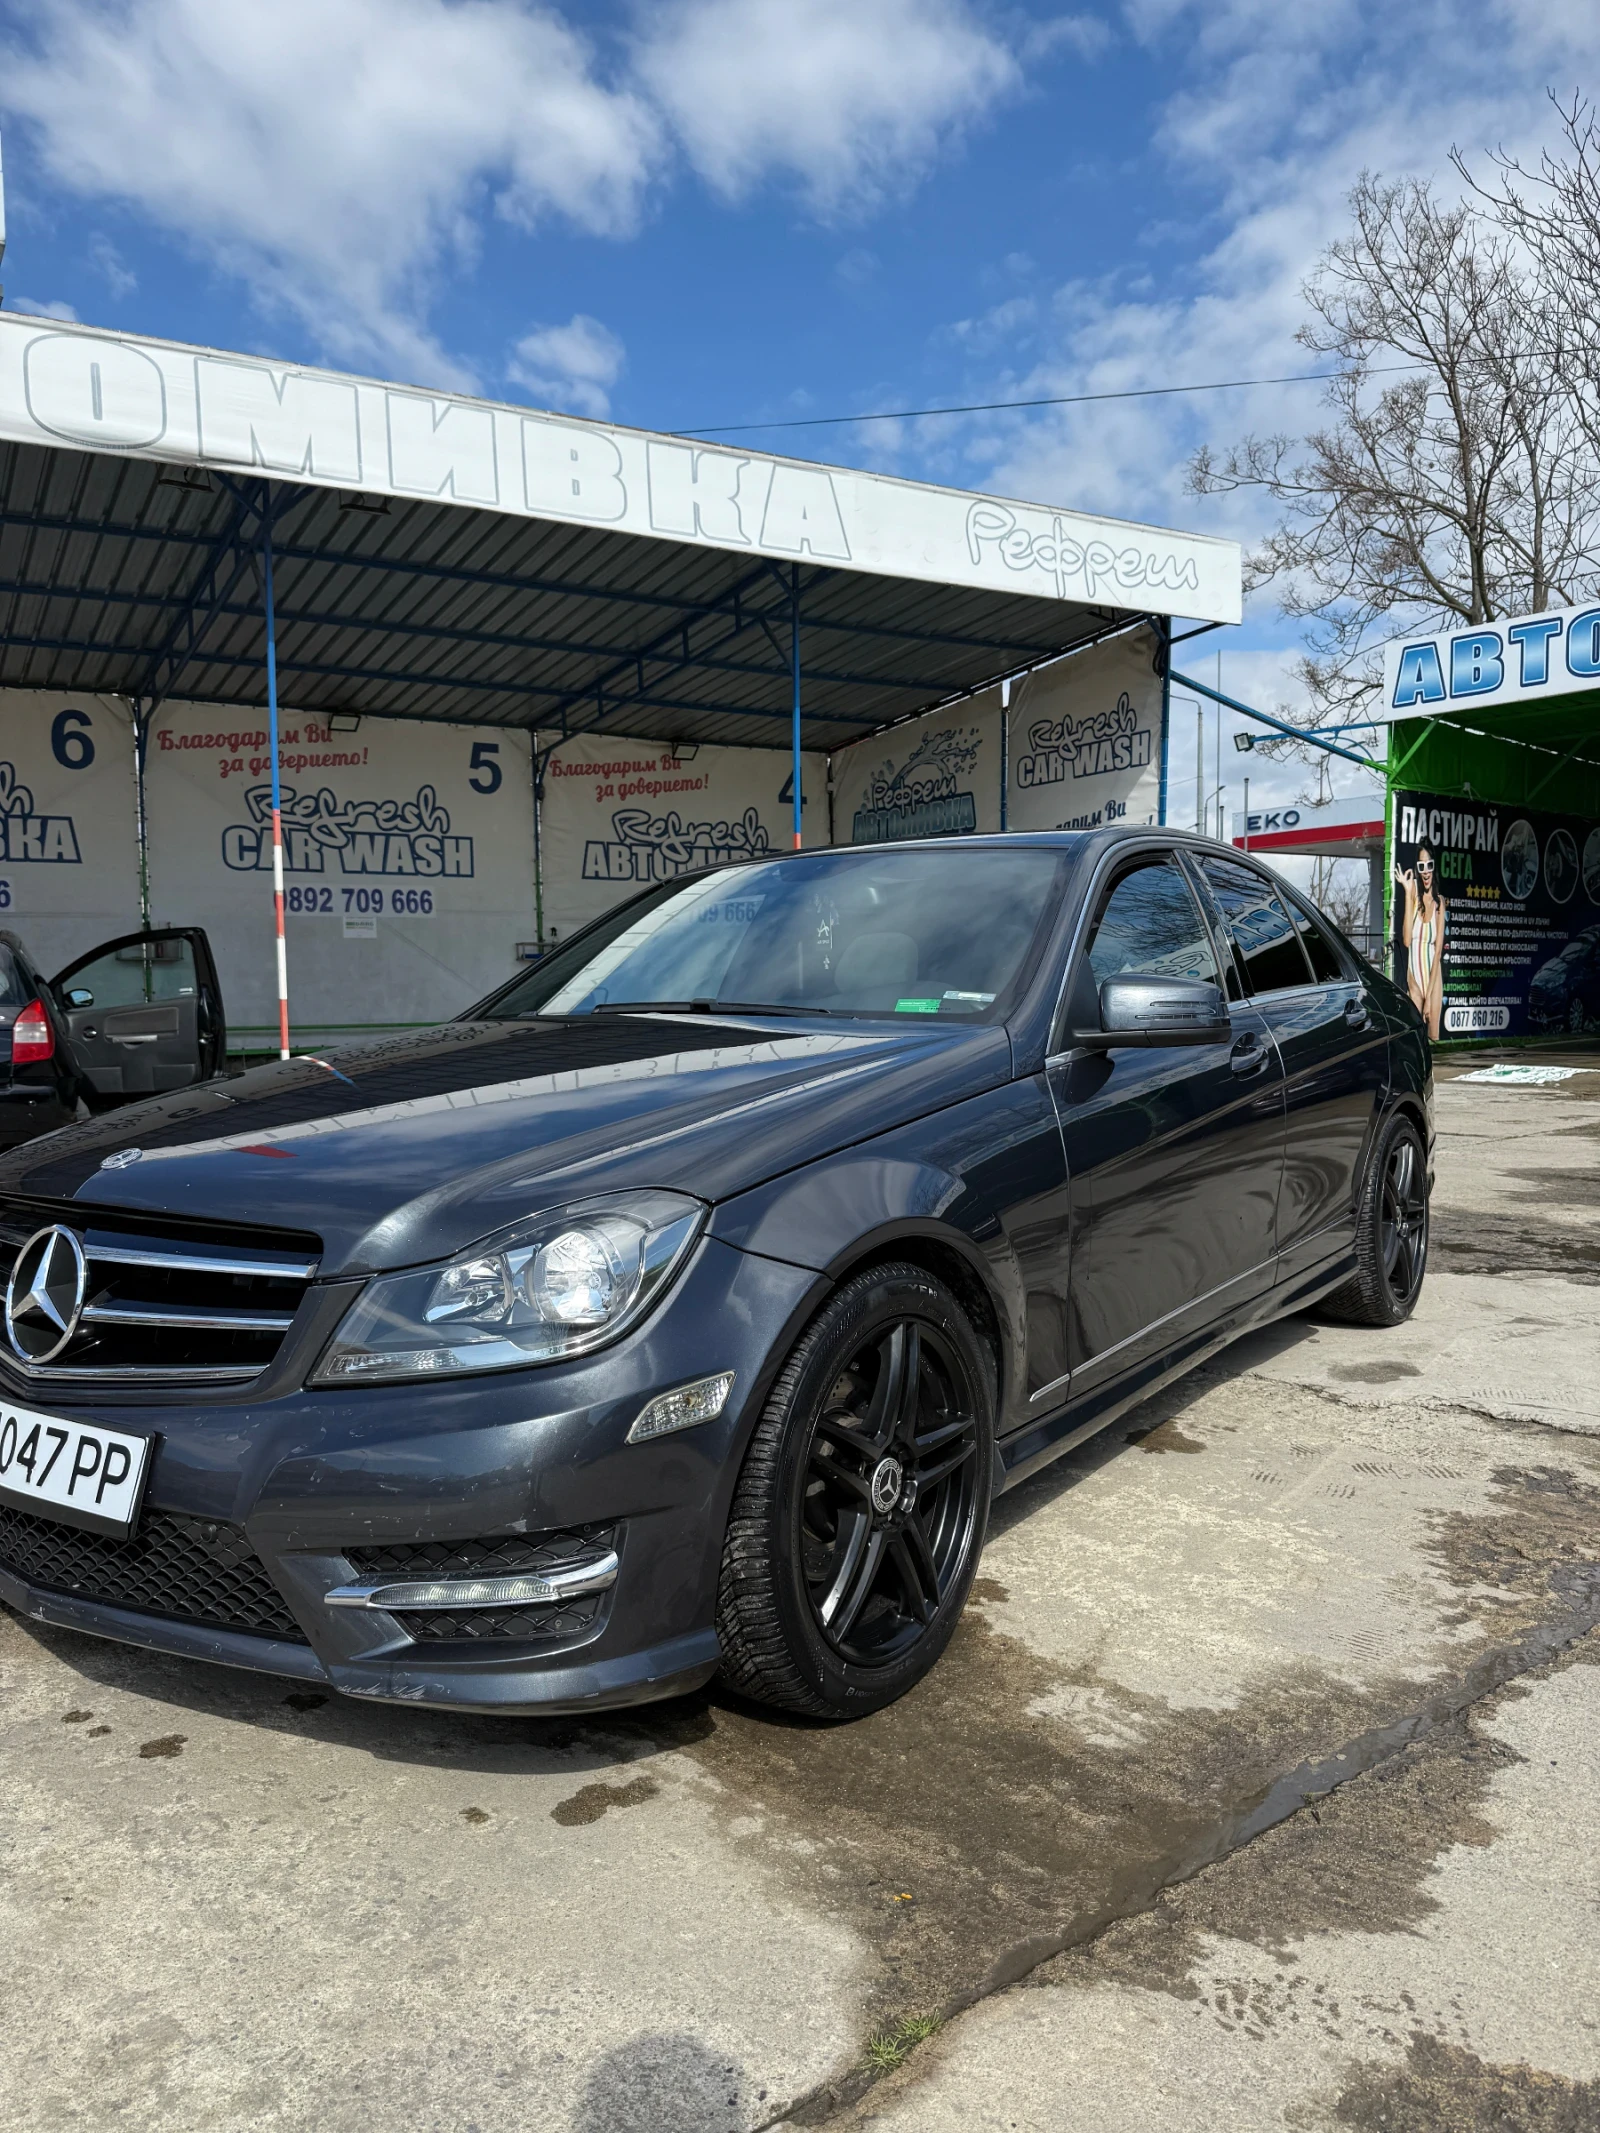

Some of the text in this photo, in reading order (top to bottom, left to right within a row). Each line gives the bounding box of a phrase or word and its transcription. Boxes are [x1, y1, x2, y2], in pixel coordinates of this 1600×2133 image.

[966, 498, 1199, 599] Рефреш
[51, 709, 96, 770] 6
[304, 723, 333, 745] Ви
[1027, 691, 1138, 762] Refresh
[219, 748, 369, 778] за доверието!
[468, 741, 503, 795] 5
[550, 759, 657, 778] Благодарим
[1016, 729, 1151, 789] CAR WASH
[595, 773, 709, 802] за доверието!
[778, 766, 808, 814] 4
[871, 774, 957, 820] Рефреш
[244, 784, 450, 848] Refresh
[1246, 809, 1301, 832] EKO
[1401, 805, 1499, 853] ПАСТИРАЙ
[611, 806, 770, 864] Refresh
[222, 825, 475, 878] CAR WASH
[1440, 851, 1473, 881] СЕГА
[341, 888, 384, 914] 709
[392, 889, 434, 915] 666
[1450, 898, 1480, 909] БЛЕСТЯЩА
[1500, 902, 1513, 910] КАТО
[1450, 912, 1474, 922] ЗАЩИТА
[1474, 914, 1482, 922] ОТ
[1450, 926, 1479, 936] ПО-ЛЕСНО
[1480, 928, 1498, 937] МИЕНЕ
[1498, 929, 1502, 937] И
[1450, 941, 1482, 951] ПРЕДПАЗВА
[1483, 942, 1500, 951] БОЯТА
[1500, 943, 1507, 951] ОТ
[1483, 955, 1498, 965] ВОДА
[1469, 995, 1487, 1006] КОЙТО
[1450, 1009, 1504, 1028] 0877 860 216
[0, 1411, 70, 1488] 047
